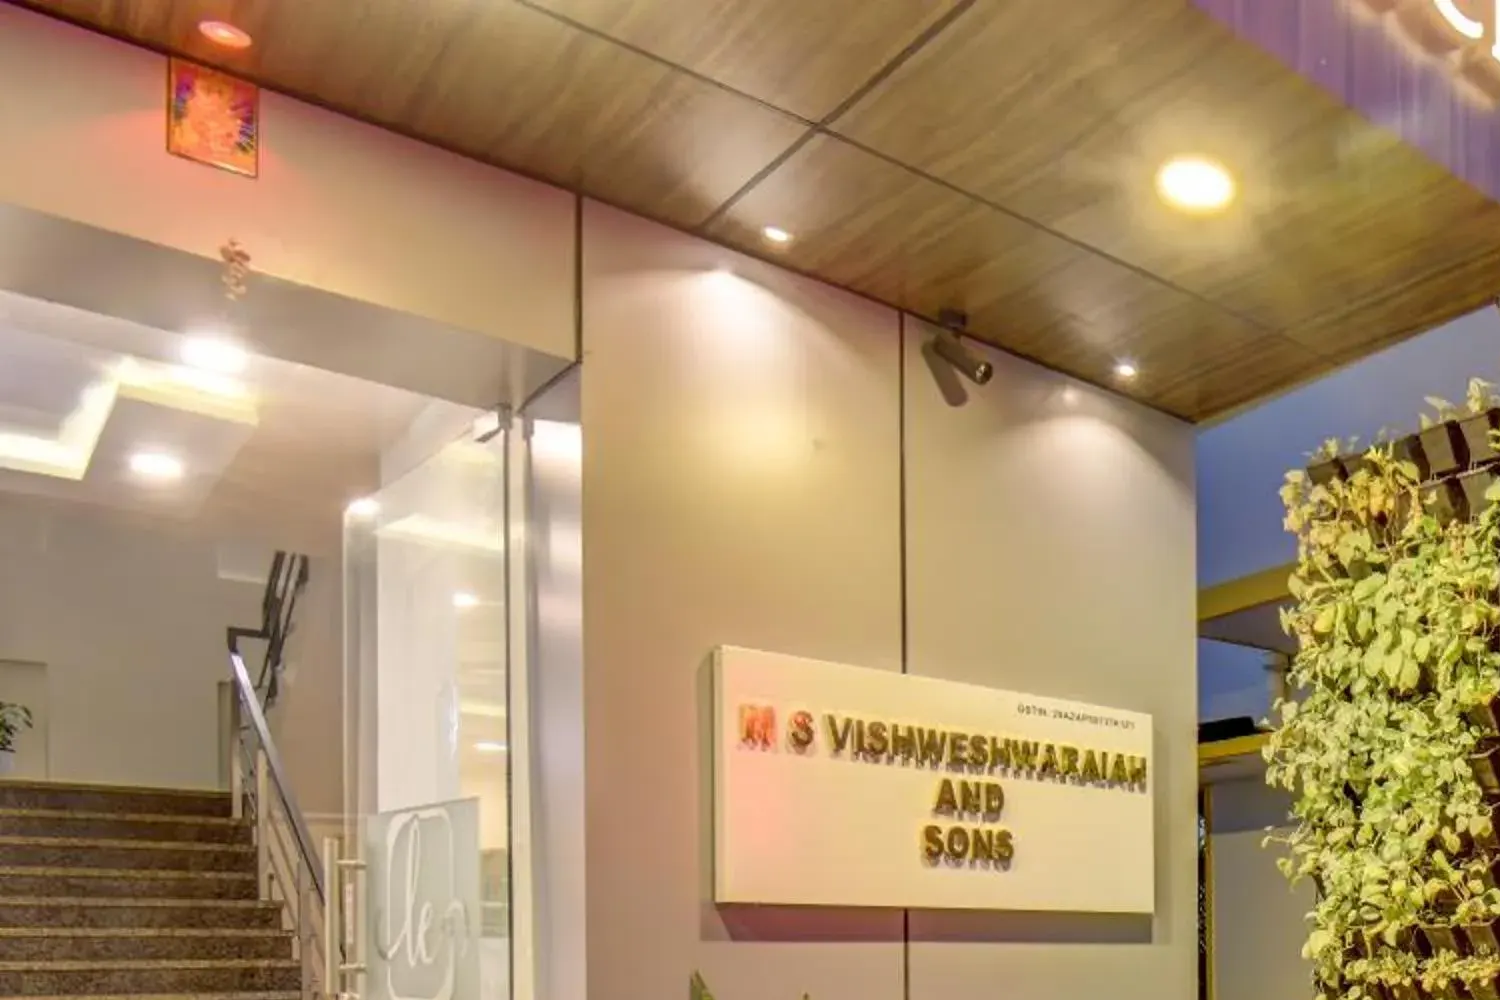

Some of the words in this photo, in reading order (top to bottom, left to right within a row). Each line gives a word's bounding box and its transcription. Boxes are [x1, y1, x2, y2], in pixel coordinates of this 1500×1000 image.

[789, 710, 815, 749] S
[933, 778, 1005, 815] AND
[922, 825, 1015, 862] SONS
